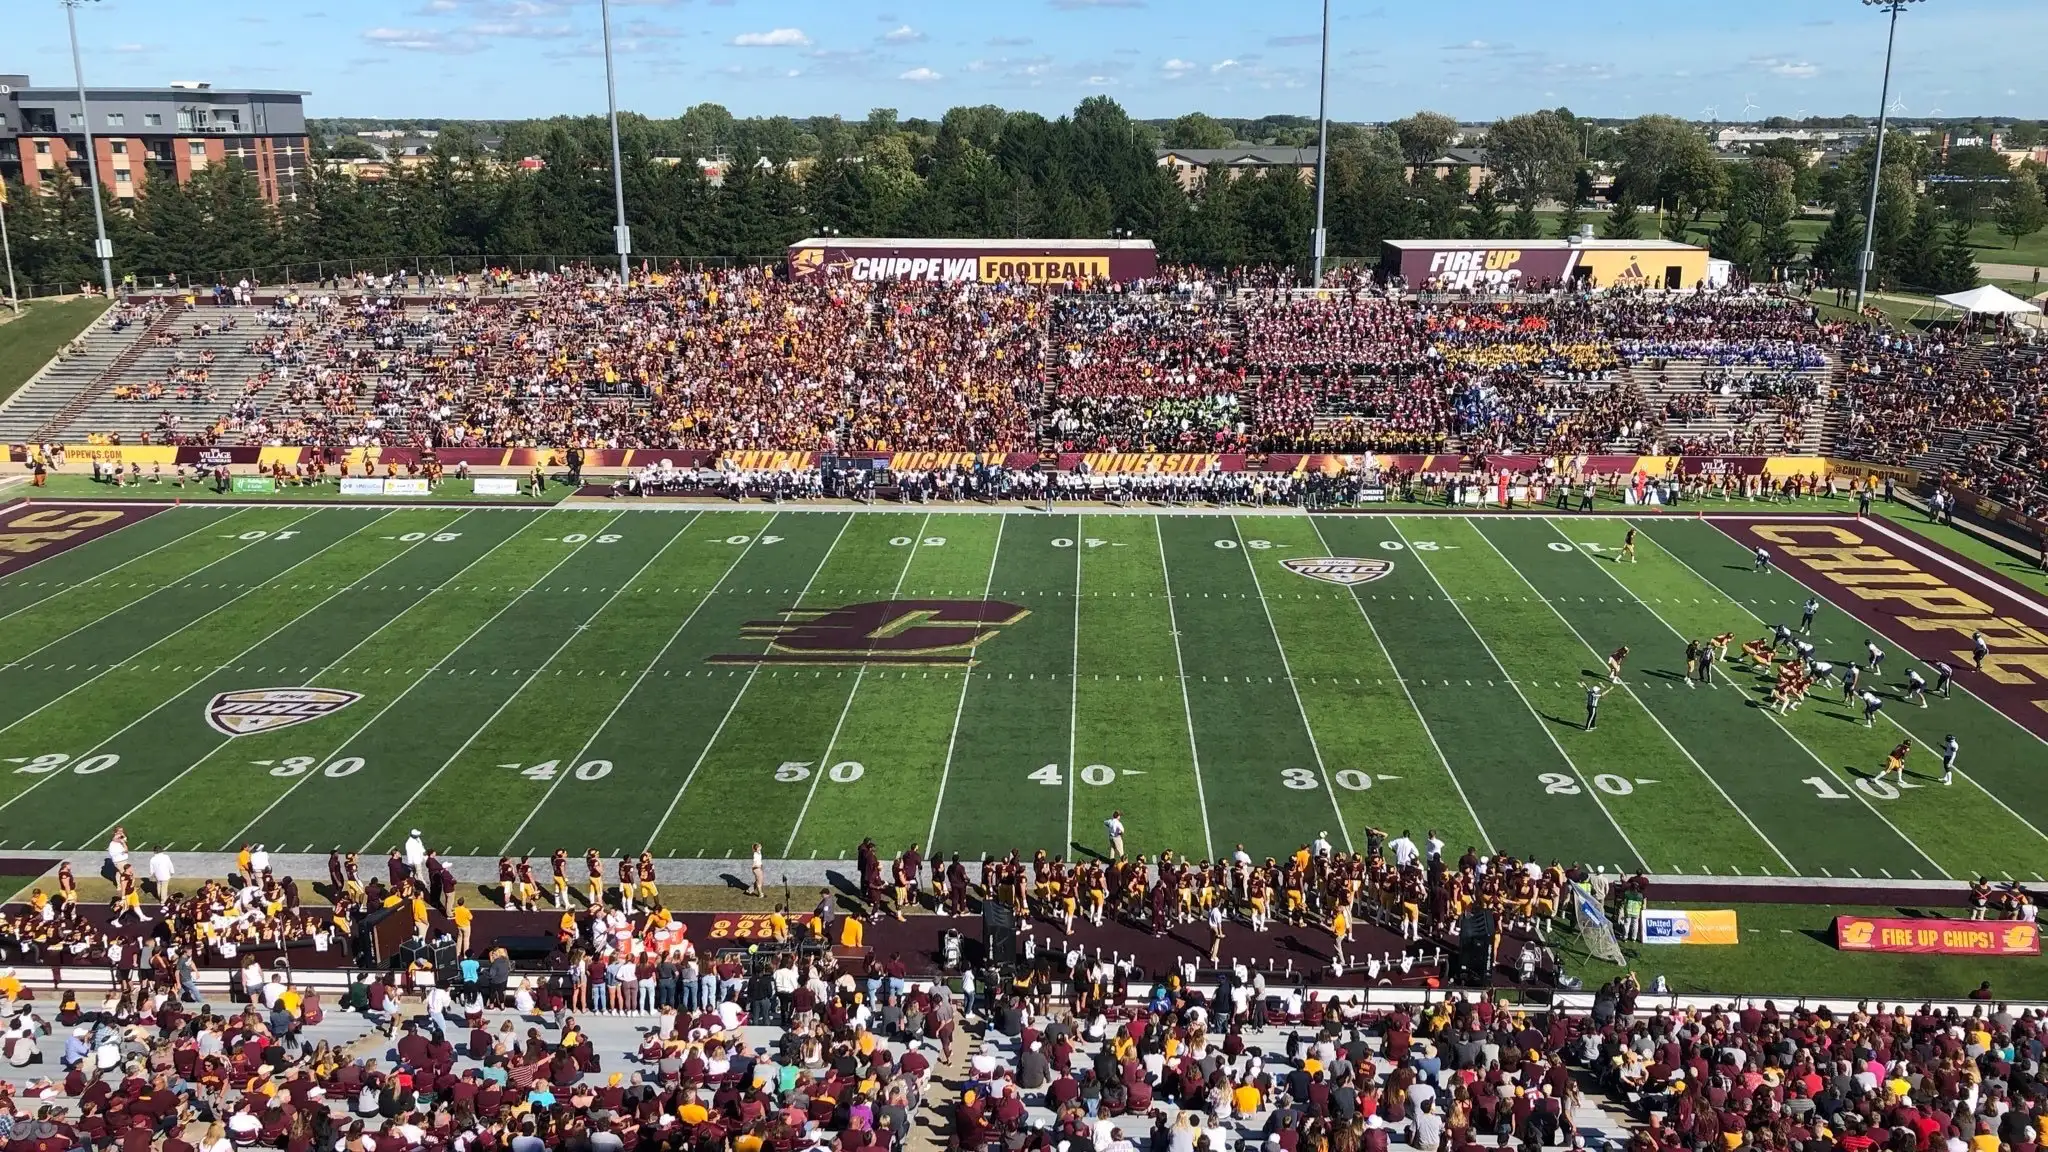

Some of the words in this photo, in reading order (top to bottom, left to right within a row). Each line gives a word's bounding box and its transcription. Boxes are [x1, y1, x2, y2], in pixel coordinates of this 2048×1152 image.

[852, 258, 977, 280] CHIPPEWA
[986, 261, 1099, 279] FOOTBALL
[1430, 251, 1486, 272] FIRE
[1485, 250, 1522, 269] UP
[65, 450, 122, 459] IPPEWAS.COM
[1083, 453, 1218, 472] UNIVERSITY
[1647, 919, 1671, 927] United
[1656, 927, 1671, 936] Way
[1881, 928, 1914, 946] FIRE
[1918, 929, 1939, 946] UP
[1943, 931, 1996, 949] CHIPS!
